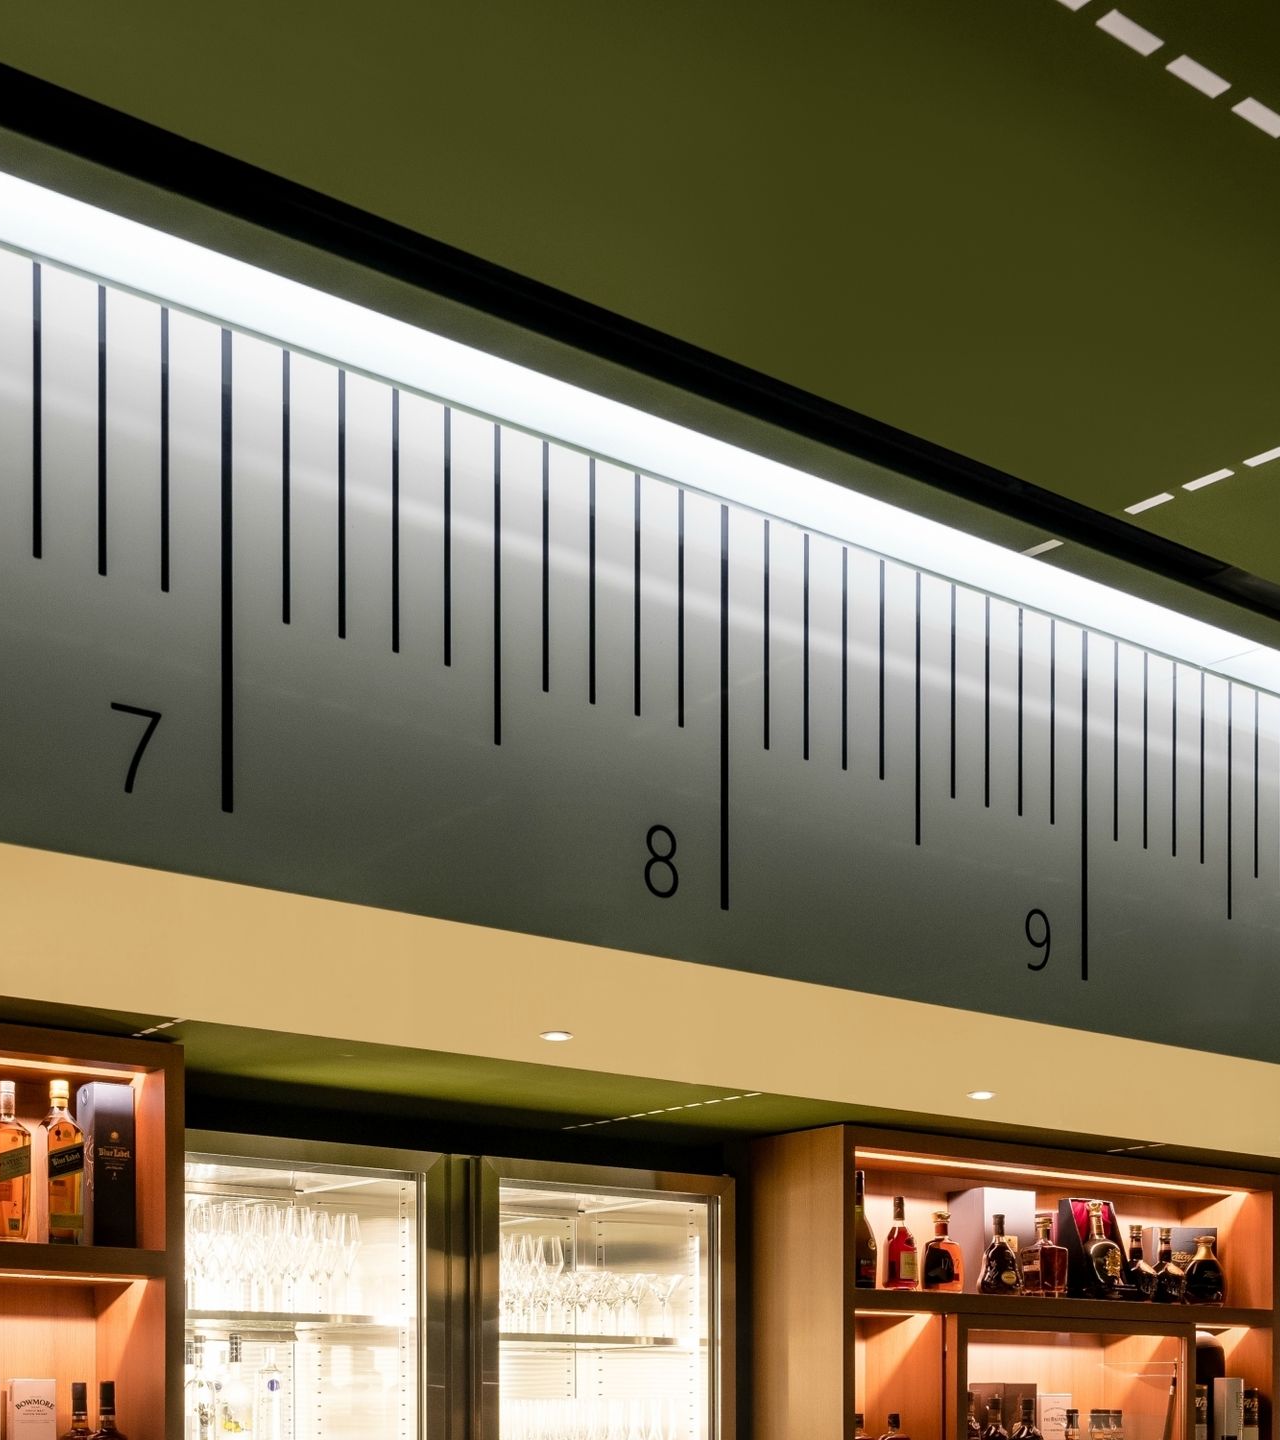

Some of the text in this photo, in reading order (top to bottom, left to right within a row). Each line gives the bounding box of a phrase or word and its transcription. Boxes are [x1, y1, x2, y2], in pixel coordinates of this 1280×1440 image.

[110, 701, 162, 793] 7
[644, 824, 679, 898] 8
[1025, 908, 1052, 971] 9
[15, 1399, 55, 1410] BOWMORE
